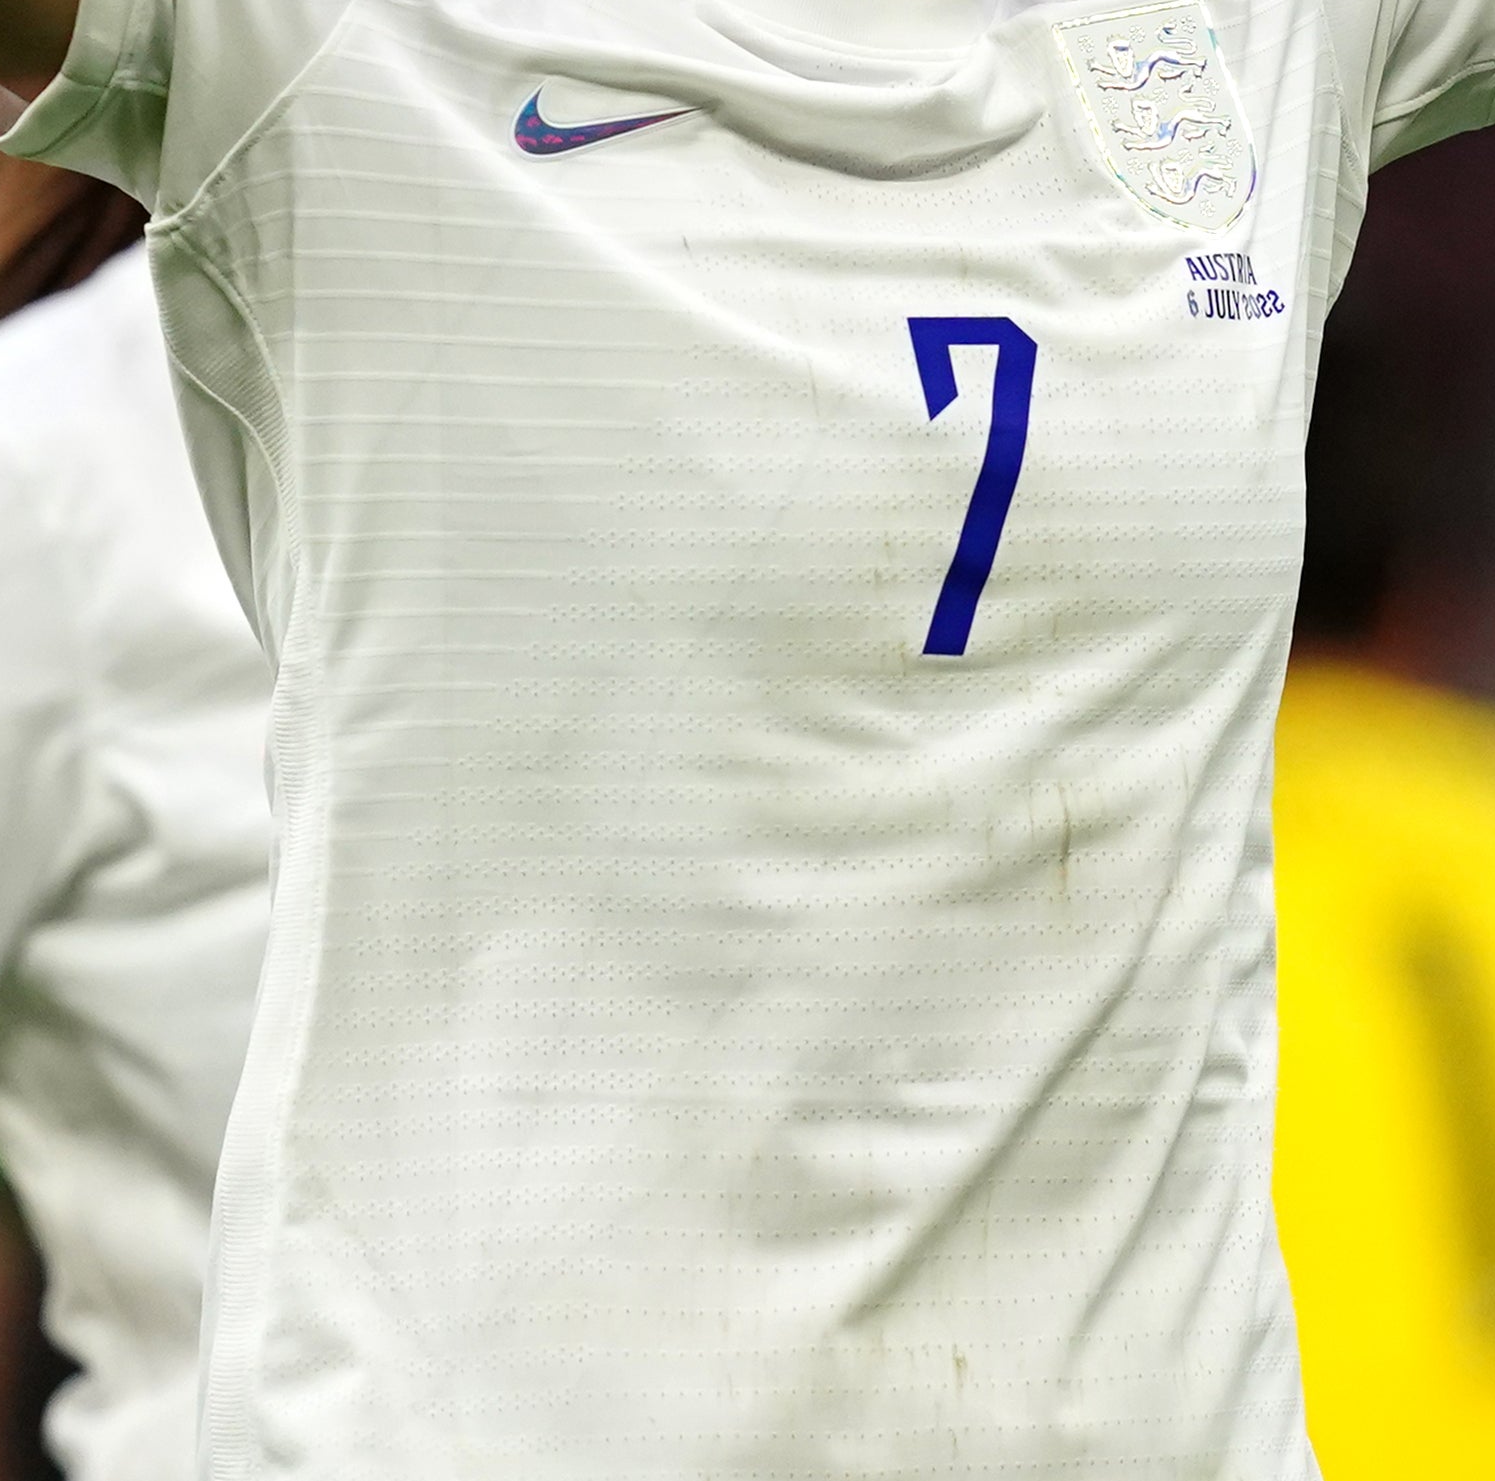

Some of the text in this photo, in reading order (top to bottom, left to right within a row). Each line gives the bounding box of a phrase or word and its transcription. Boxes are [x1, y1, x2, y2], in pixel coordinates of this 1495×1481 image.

[1185, 253, 1257, 285] AUSTRIA
[1187, 290, 1199, 317] 6
[1205, 289, 1241, 320] JULY
[907, 317, 1038, 655] 7
